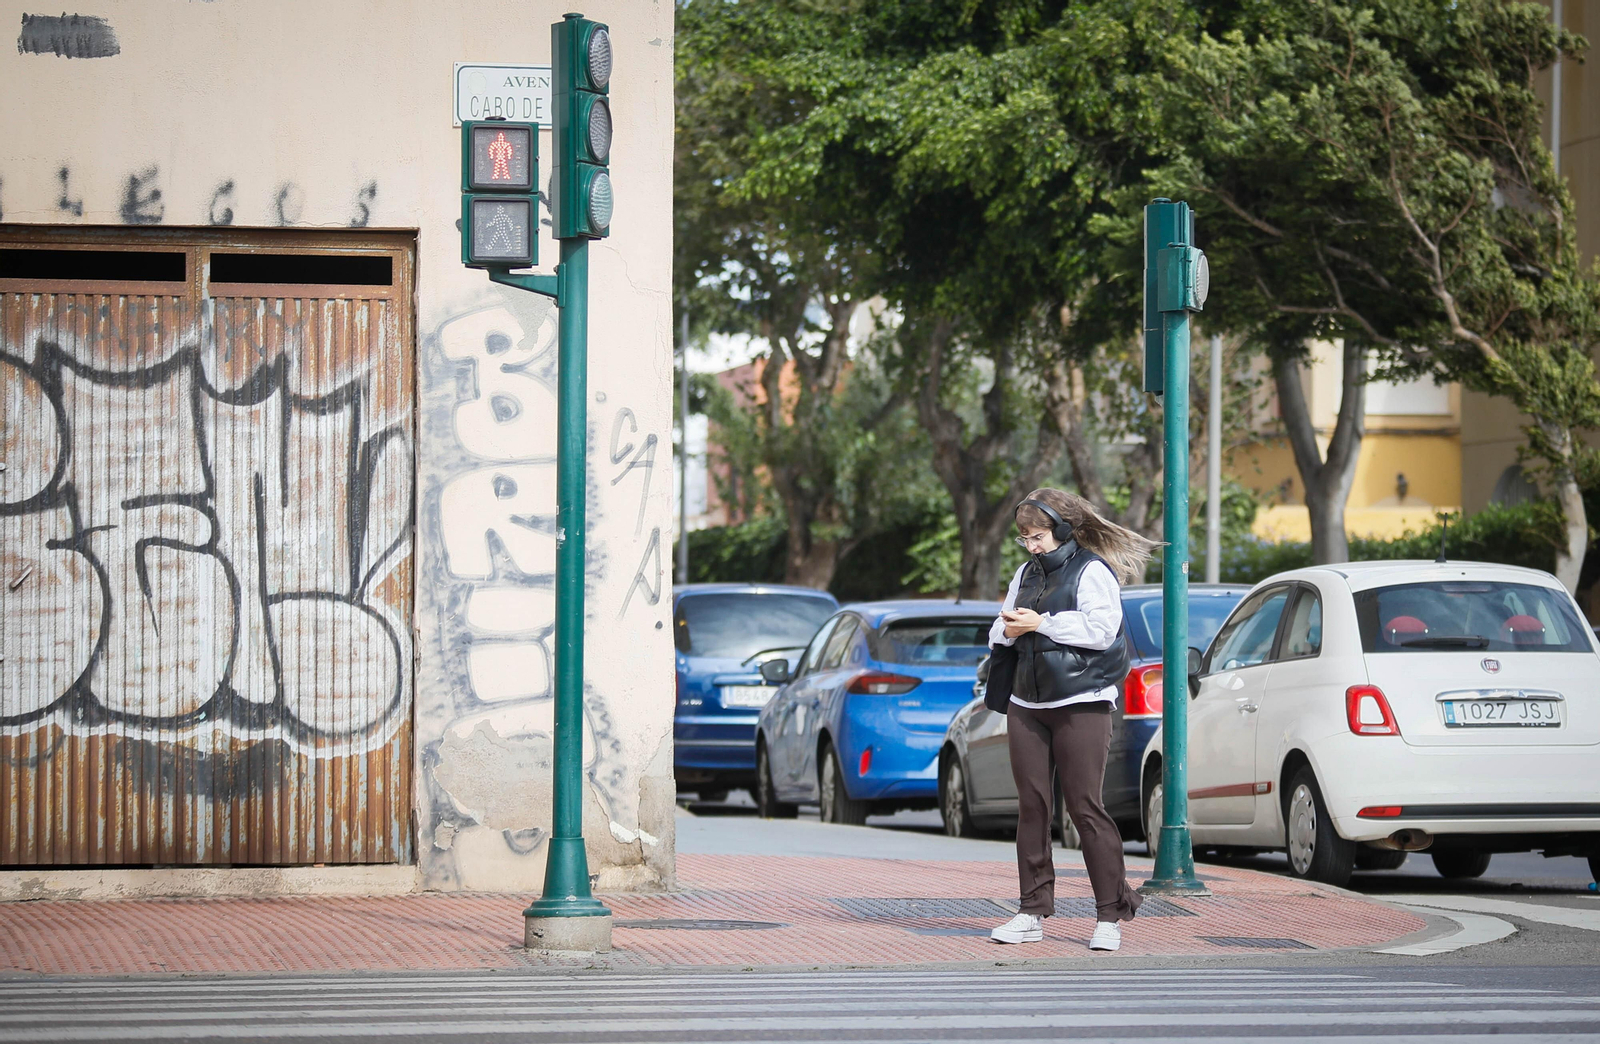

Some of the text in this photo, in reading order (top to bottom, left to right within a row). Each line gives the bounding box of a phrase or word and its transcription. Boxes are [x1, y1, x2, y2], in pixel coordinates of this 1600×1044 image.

[470, 95, 543, 119] CABO DE
[1459, 702, 1554, 720] 1027 JSJ
